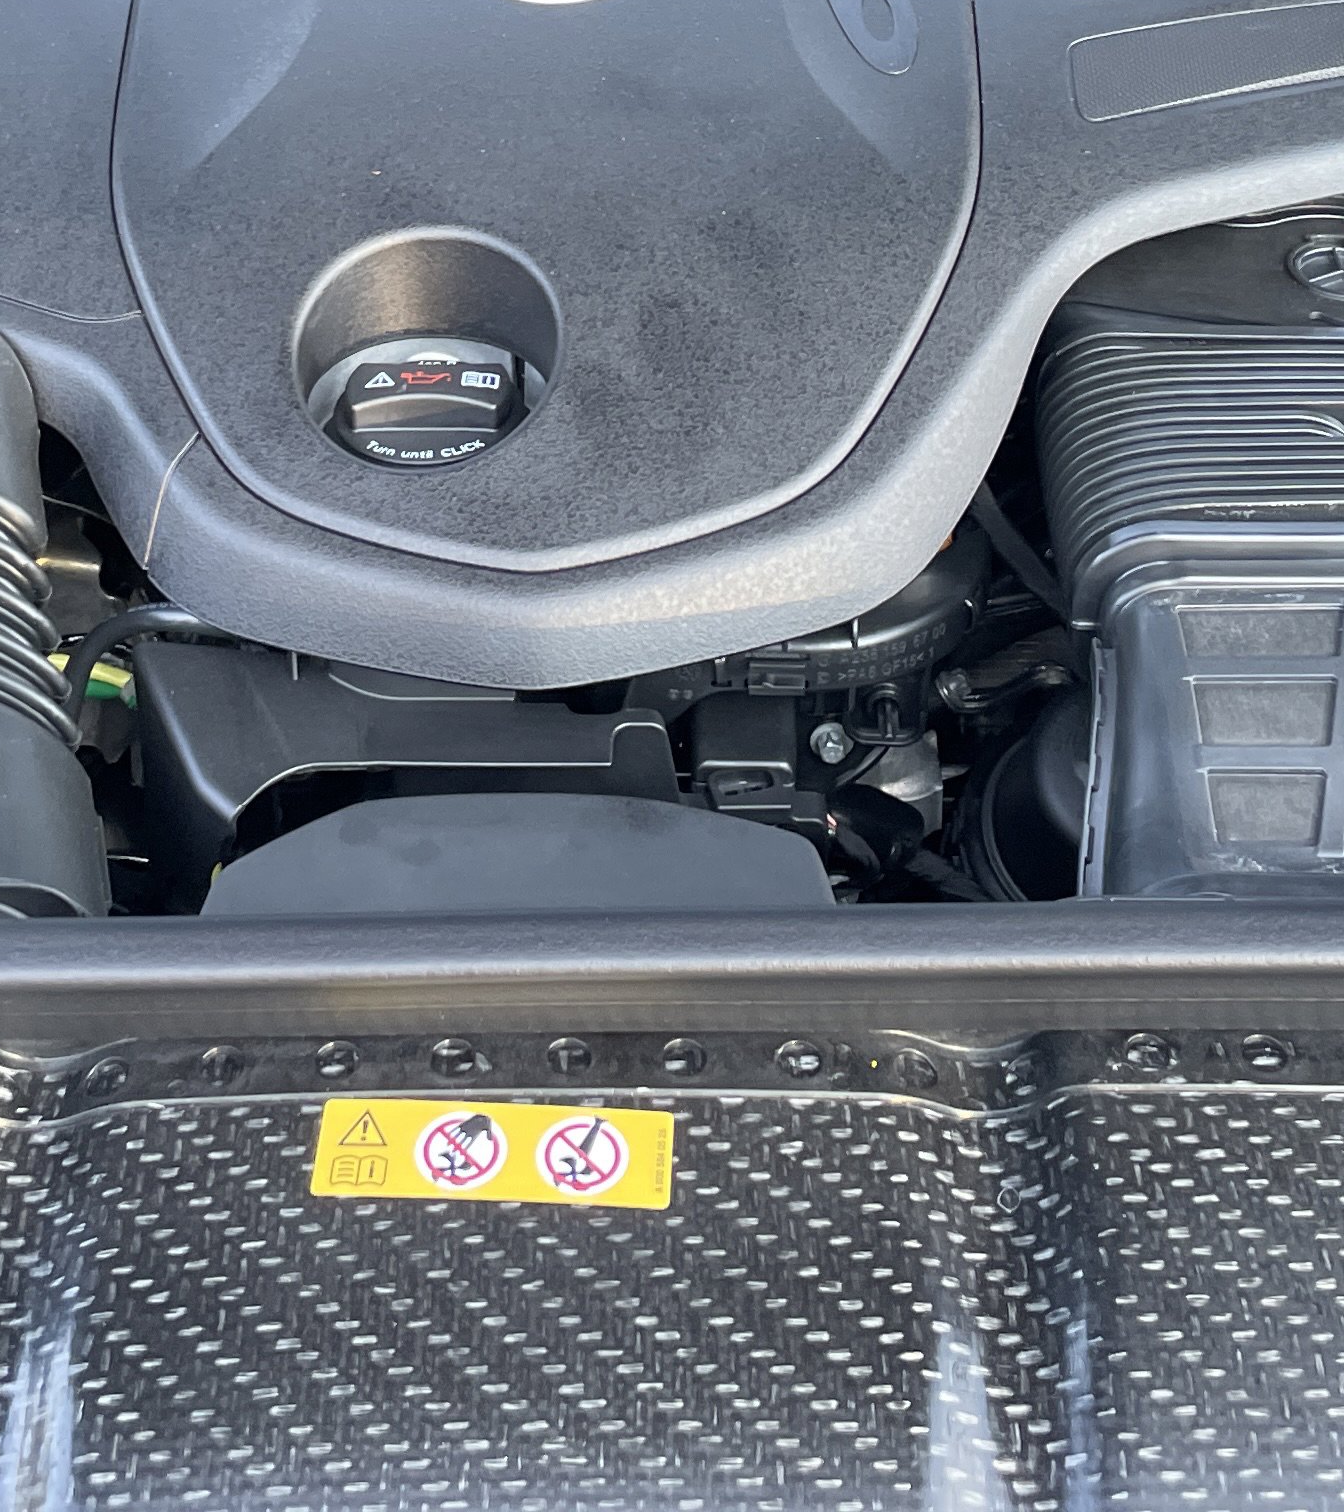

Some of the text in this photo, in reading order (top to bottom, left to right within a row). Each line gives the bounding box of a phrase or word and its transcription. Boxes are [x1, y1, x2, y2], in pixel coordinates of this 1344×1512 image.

[366, 439, 486, 459] Turn until CLICK
